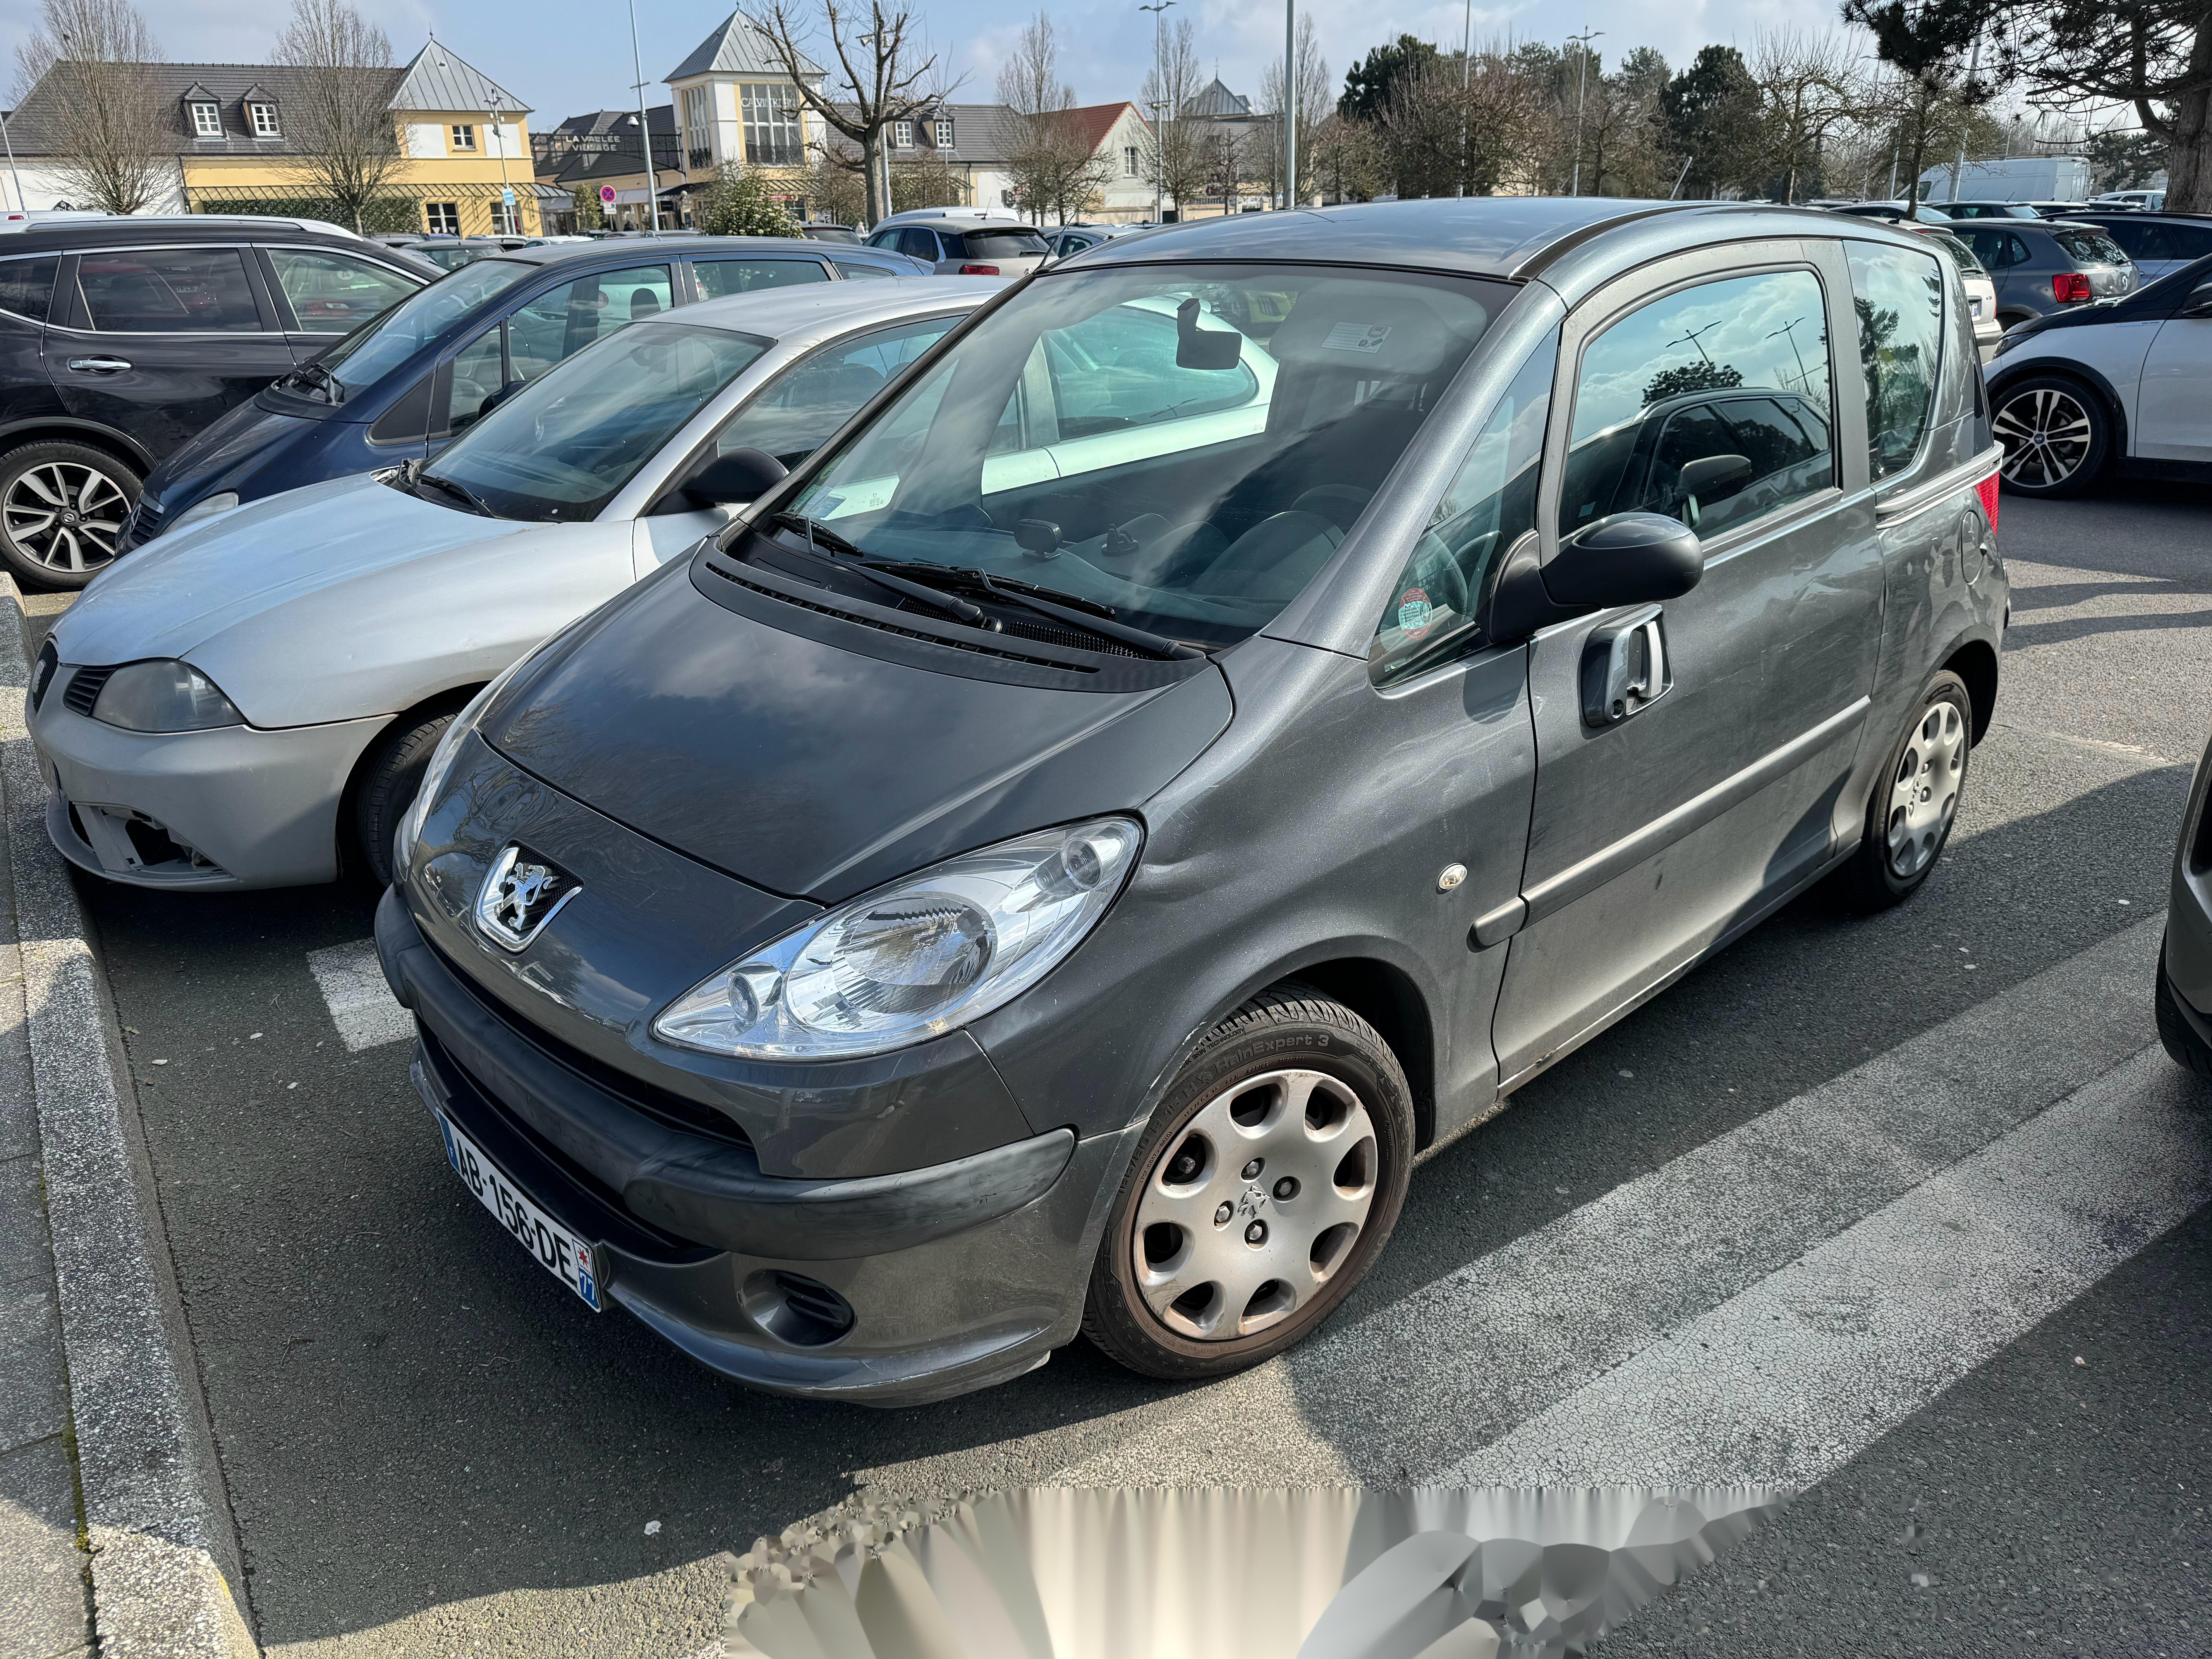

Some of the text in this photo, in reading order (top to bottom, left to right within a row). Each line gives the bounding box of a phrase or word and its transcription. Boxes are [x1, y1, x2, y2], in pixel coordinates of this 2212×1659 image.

[581, 132, 620, 143] VALLÉE
[1179, 1027, 1245, 1071] ARK SKIN TECHNOLOGY
[1214, 1035, 1312, 1074] RainExpert
[1318, 1034, 1329, 1047] 3
[1357, 1039, 1384, 1066] OUTSIDE
[449, 1146, 453, 1157] F
[457, 1138, 577, 1289] AB-156-DE
[579, 1271, 594, 1301] 77
